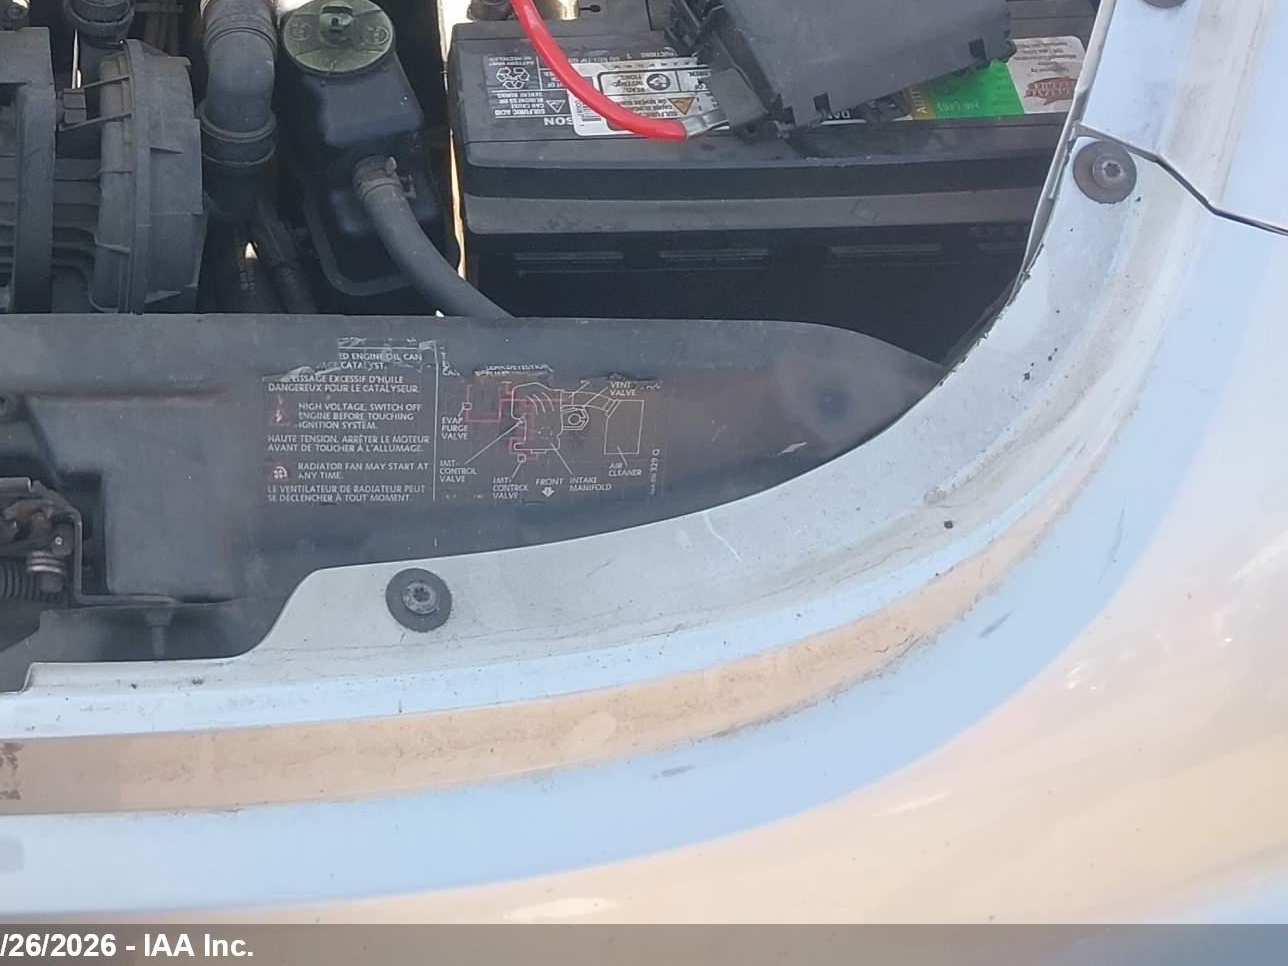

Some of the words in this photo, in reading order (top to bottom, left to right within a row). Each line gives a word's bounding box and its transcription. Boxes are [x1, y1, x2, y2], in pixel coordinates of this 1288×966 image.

[298, 402, 322, 411] HIGH
[369, 403, 405, 412] SWITCH
[332, 412, 364, 420] BEFORE
[366, 412, 414, 421] TOUCHING
[298, 421, 338, 430] IGNITION
[267, 434, 297, 444] HAUTE
[392, 434, 430, 443] MOTEUR
[441, 432, 469, 440] VALVE
[267, 444, 298, 452] AVANT
[314, 444, 355, 452] TOUCHER
[298, 462, 343, 470] RADIATOR
[344, 462, 362, 470] FAN
[364, 462, 387, 470] MAY
[388, 462, 414, 471] START
[298, 472, 318, 480] ANY
[608, 469, 643, 477] CLEANER
[440, 476, 466, 484] VALVE
[536, 478, 564, 486] FRONT
[569, 476, 598, 484] INTAKE
[278, 484, 337, 494] VENTILATEUR
[353, 484, 402, 494] RADIATEUR
[404, 484, 426, 494] PEUT
[492, 484, 528, 492] CONTROL
[568, 484, 612, 492] MANIFOLD
[344, 494, 367, 502] TOUT
[492, 492, 519, 500] VALVE
